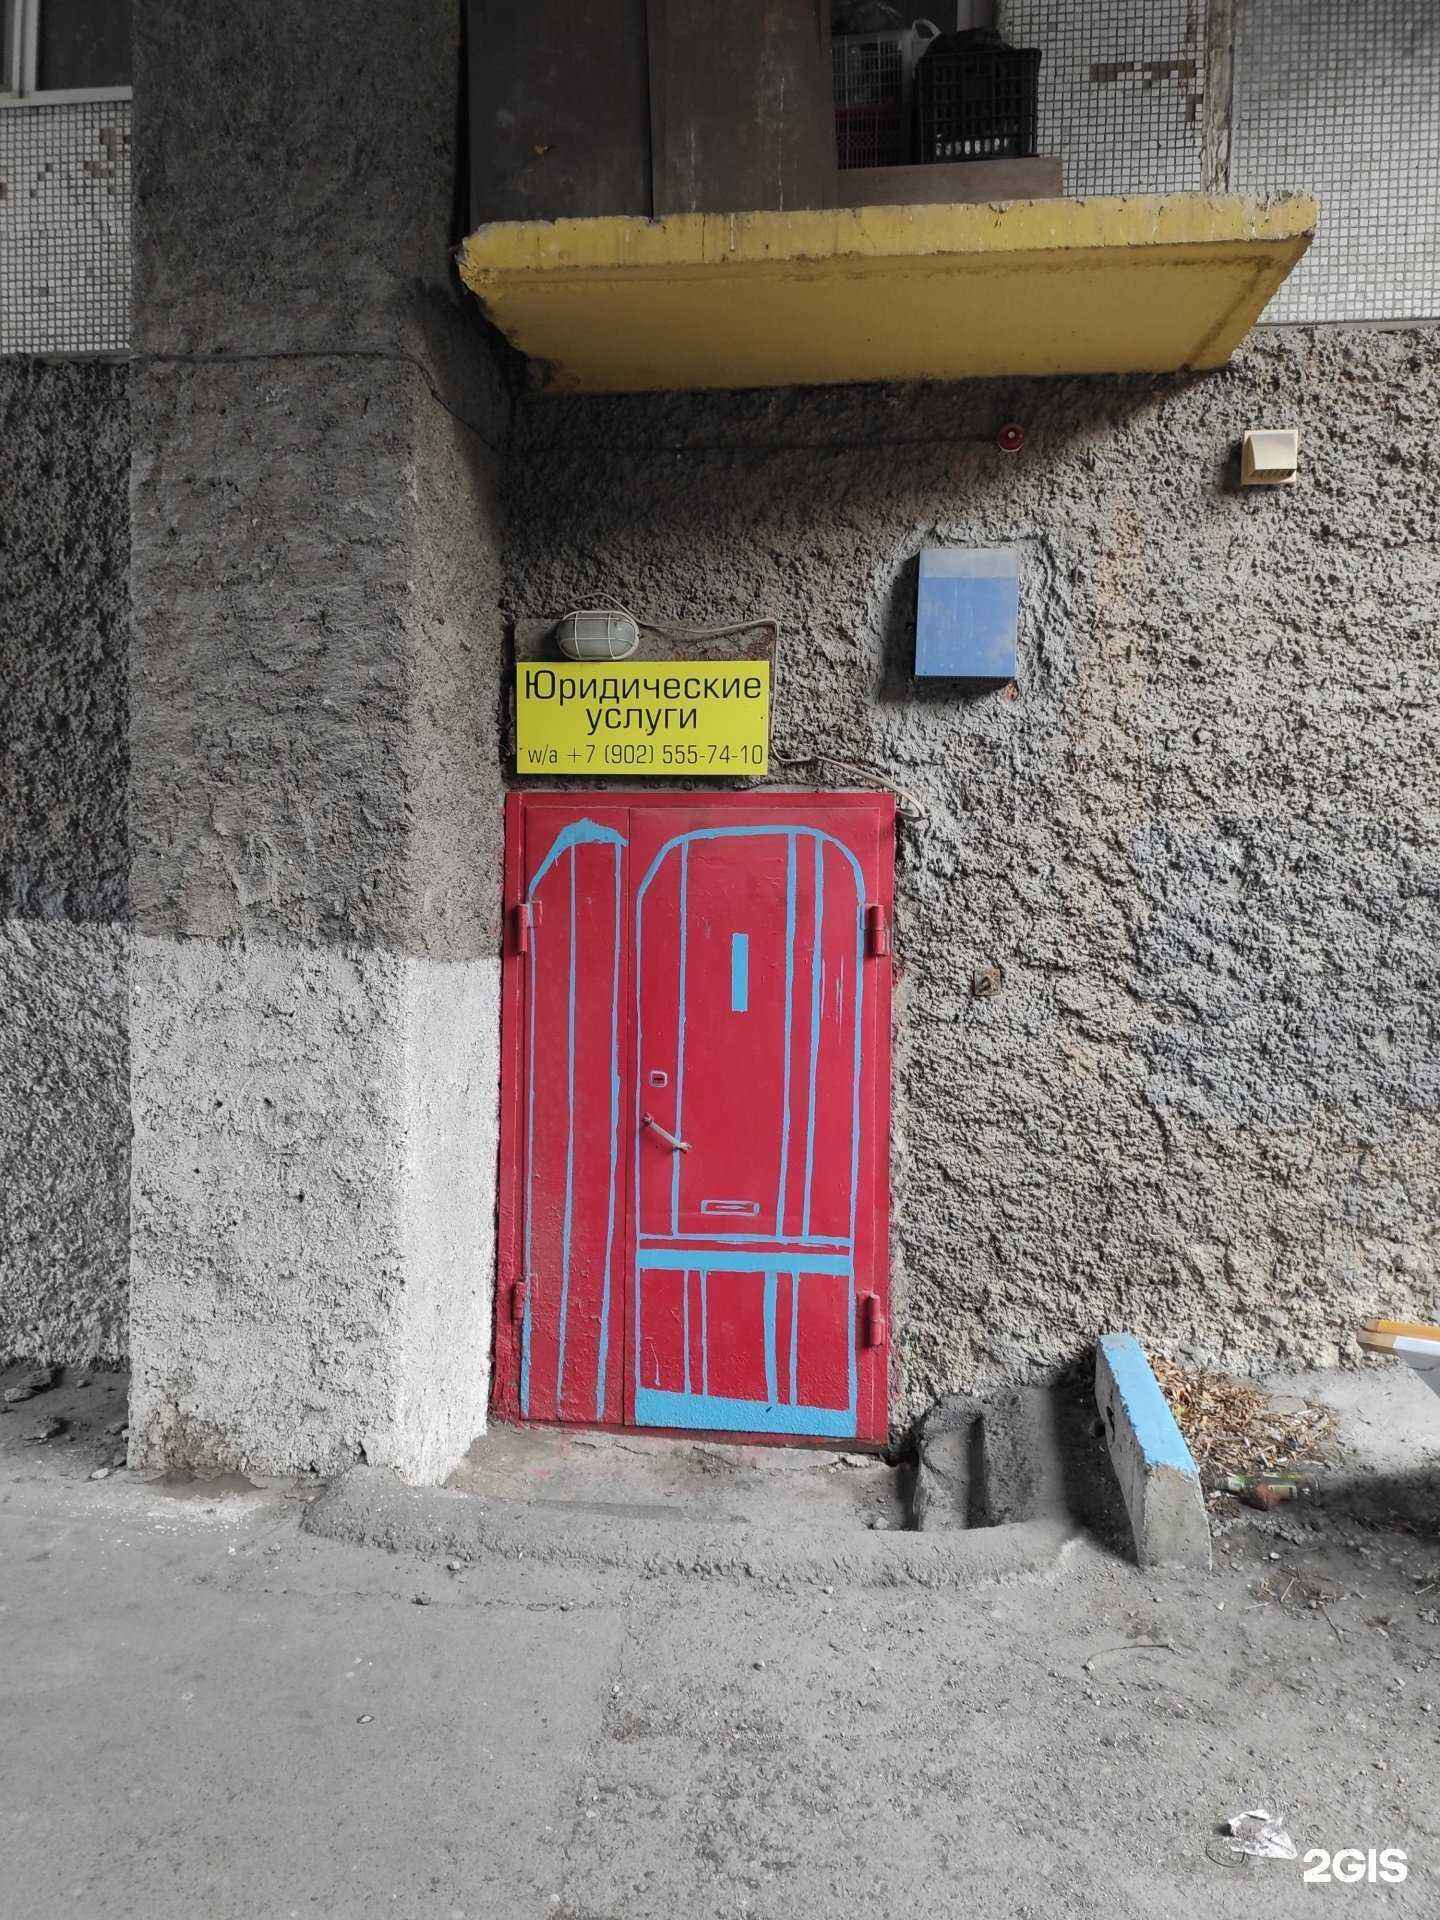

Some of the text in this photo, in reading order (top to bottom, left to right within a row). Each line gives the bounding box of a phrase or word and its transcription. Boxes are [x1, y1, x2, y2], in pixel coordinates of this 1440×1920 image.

[525, 669, 761, 706] Юридические
[586, 707, 697, 736] услуги
[528, 744, 558, 764] w/a
[604, 743, 654, 765] (902)
[662, 744, 763, 765] 555-74-10
